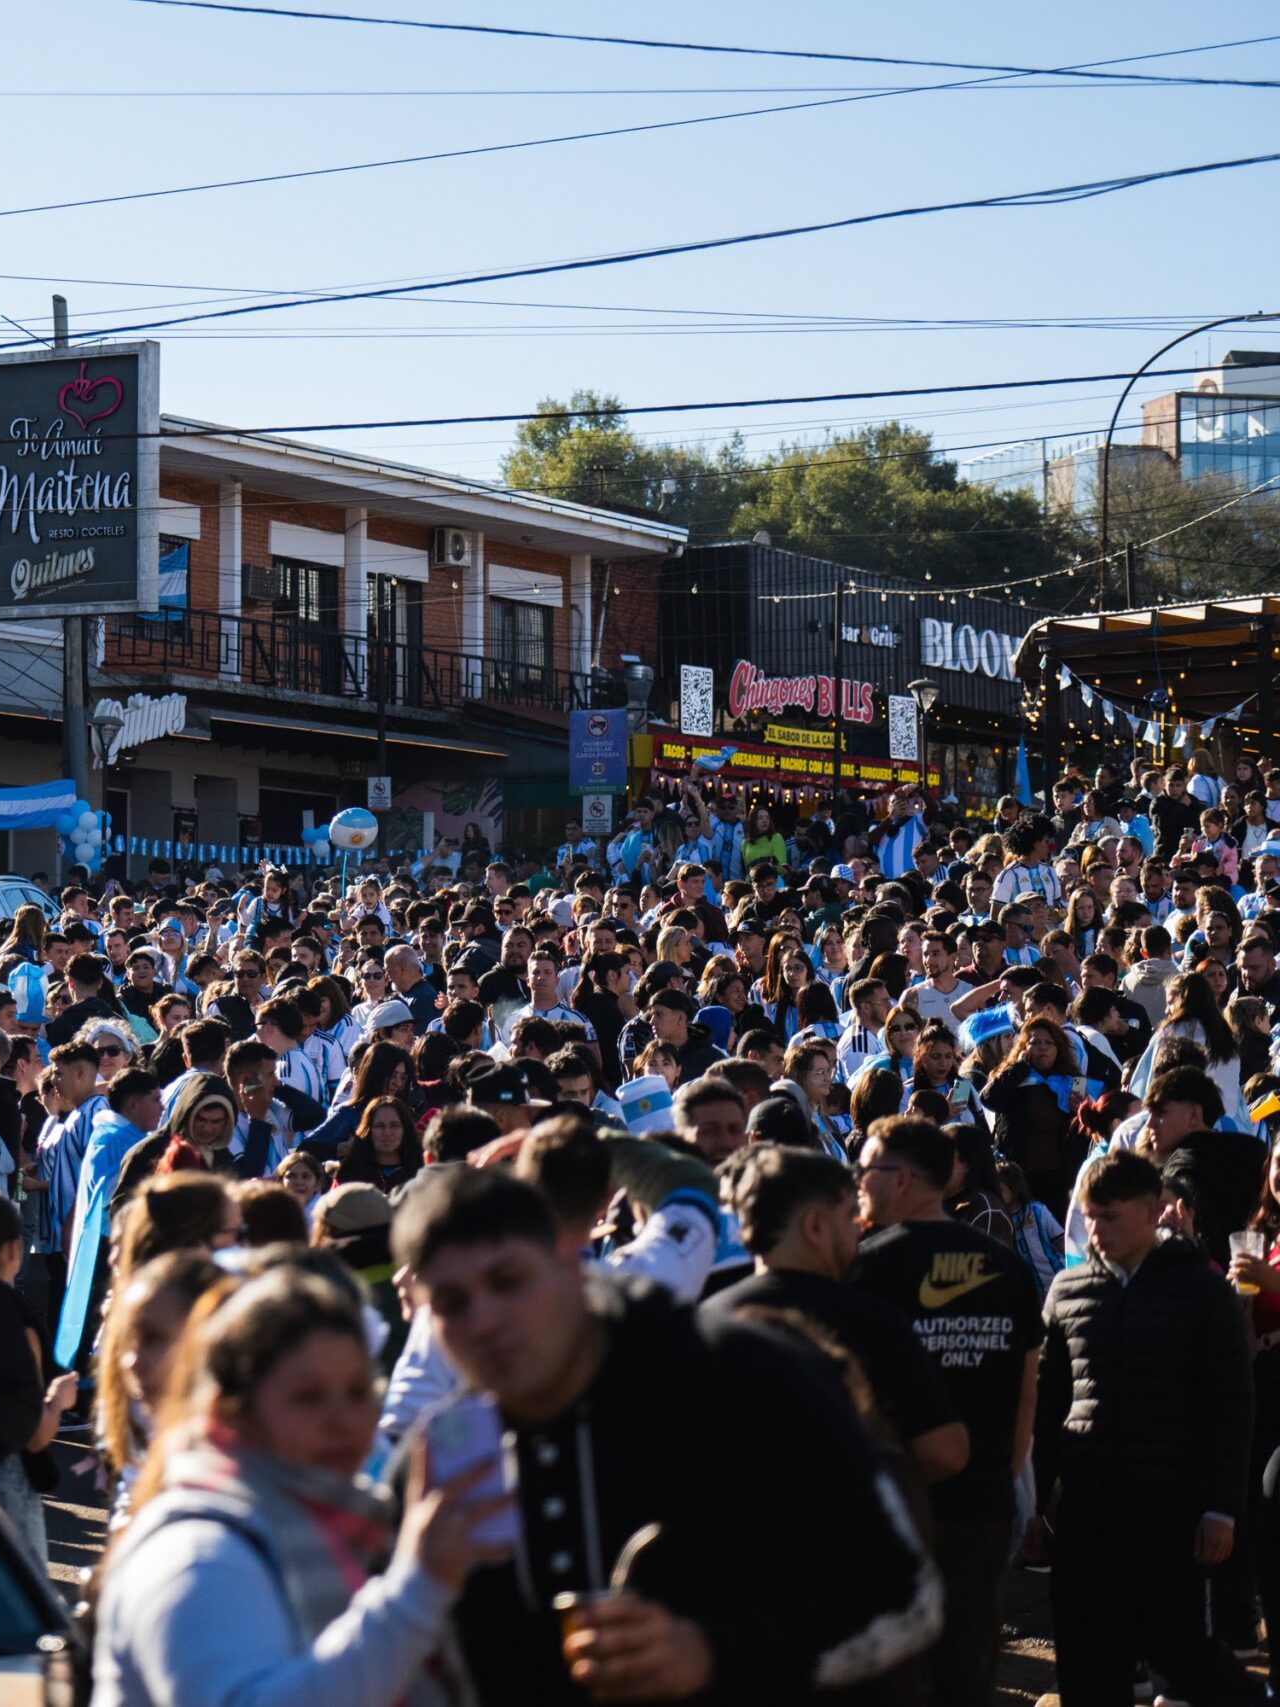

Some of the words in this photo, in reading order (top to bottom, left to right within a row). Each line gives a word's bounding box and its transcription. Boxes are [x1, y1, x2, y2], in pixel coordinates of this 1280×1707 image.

[10, 417, 39, 456] Te
[41, 418, 104, 461] Amaré
[81, 524, 125, 537] COCTELES
[10, 546, 95, 600] Quilmes
[729, 659, 816, 718] Chingones
[91, 692, 187, 771] Quilmes
[768, 727, 776, 738] EL
[777, 729, 800, 742] SABOR
[801, 733, 810, 743] DE
[811, 733, 821, 745] LA
[822, 734, 834, 746] CAL
[593, 764, 603, 773] 20
[663, 744, 686, 759] TACOS
[731, 752, 775, 769] QUESADILLAS
[780, 757, 807, 773] NACHOS
[808, 760, 823, 775] CON
[824, 762, 855, 777] CAITAS
[898, 769, 919, 784] LOMOS
[927, 773, 940, 788] ÇAI
[931, 1252, 986, 1282] NIKE
[912, 1315, 1013, 1334] AUTHORZED
[941, 1351, 984, 1367] ONLY
